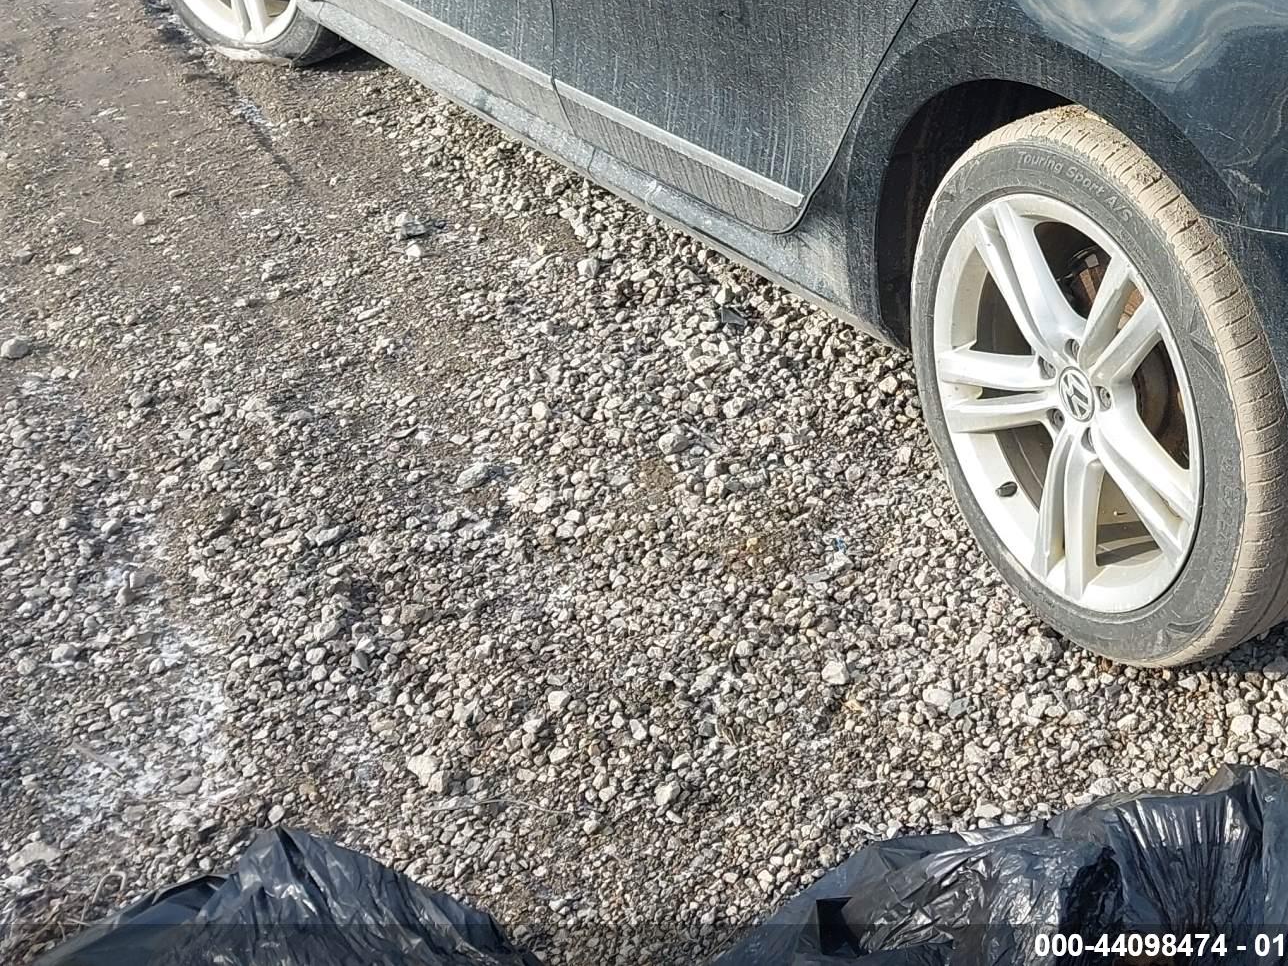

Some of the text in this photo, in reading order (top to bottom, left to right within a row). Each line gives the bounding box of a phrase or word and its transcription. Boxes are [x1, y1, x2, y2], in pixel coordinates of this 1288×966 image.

[1018, 151, 1133, 222] Touring Sport A/S
